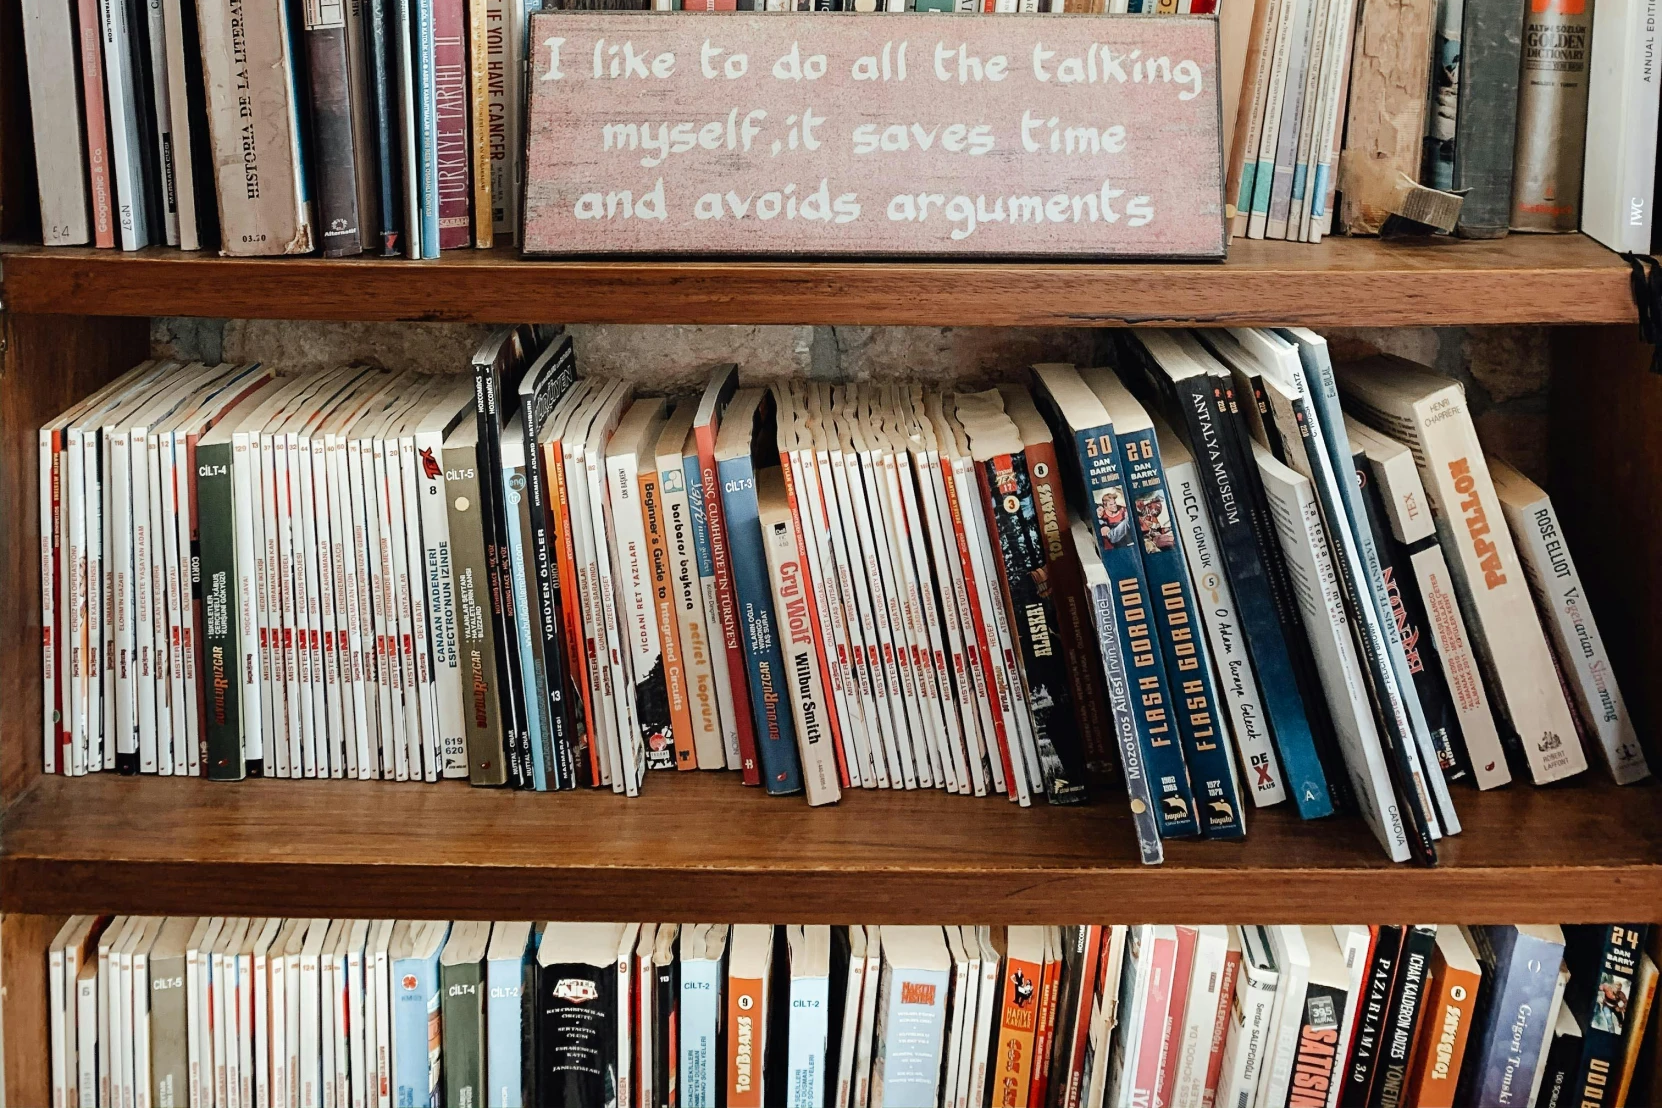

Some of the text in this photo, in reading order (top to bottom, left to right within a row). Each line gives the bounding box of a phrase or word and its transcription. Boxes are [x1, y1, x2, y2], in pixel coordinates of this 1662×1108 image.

[487, 8, 502, 20] IF
[487, 26, 503, 55] YOU
[1526, 34, 1585, 49] GOLDEN
[1526, 48, 1585, 61] DICTIONARY
[1642, 37, 1655, 83] ANNUAL
[236, 69, 249, 90] LA
[487, 61, 504, 97] HAVE
[540, 35, 1203, 102] I like to do all the talking
[238, 96, 252, 118] DE
[852, 116, 996, 157] saves
[1020, 108, 1128, 155] time
[241, 124, 260, 199] HISTORIA
[572, 177, 1156, 240] and avoids arguments
[1629, 196, 1645, 227] IWC
[1084, 435, 1113, 458] 30
[1093, 458, 1111, 467] DAN
[1125, 439, 1153, 462] 26
[1191, 393, 1241, 525] ANTALYA MUSEUM
[1089, 464, 1117, 476] BARRY
[1131, 468, 1158, 480] BARRY
[1133, 462, 1152, 472] DAN
[429, 485, 437, 496] 8
[1402, 493, 1420, 522] TEX
[1447, 457, 1508, 591] PAPILLON
[191, 556, 200, 583] CORTO
[702, 469, 737, 649] GENÇ CUMHURİYET'İN TÜRKİYE'Sİ
[537, 529, 554, 640] YÜRÜYEN ÖLÜLER
[644, 483, 683, 711] Beginner's Guide to Integrated Circuits
[427, 548, 446, 663] CANAAN MADENLERİ
[439, 541, 458, 668] ESPECTRO'NUN İZİNDE
[1532, 509, 1620, 723] ROSE ELLIOT Vegetarian Slimming
[1025, 601, 1053, 657] ALASKA!
[779, 560, 822, 745] Cry Wolf Wilbur Smith
[1117, 577, 1172, 748] FLASH GORDON
[1160, 581, 1217, 751] FLASH GORDON
[1215, 608, 1262, 742] O Adam Buraya Gelecek
[1258, 783, 1276, 792] PLUS
[1387, 804, 1407, 847] CANOVA
[1610, 925, 1639, 950] 24
[1613, 947, 1631, 958] DAN
[618, 961, 627, 973] 9
[1606, 954, 1635, 966] BARRY
[683, 980, 711, 991] CİLT-2
[792, 999, 820, 1010] CİLT-2
[1353, 958, 1391, 1083] PAZARLAMA 3.0
[1390, 953, 1424, 1060] ICHAK KALDERON ADIZES
[735, 1015, 754, 1094] TOMBRAKS
[1431, 1004, 1462, 1080] TOMBRAKS
[1499, 1003, 1533, 1105] Grigori Tomski
